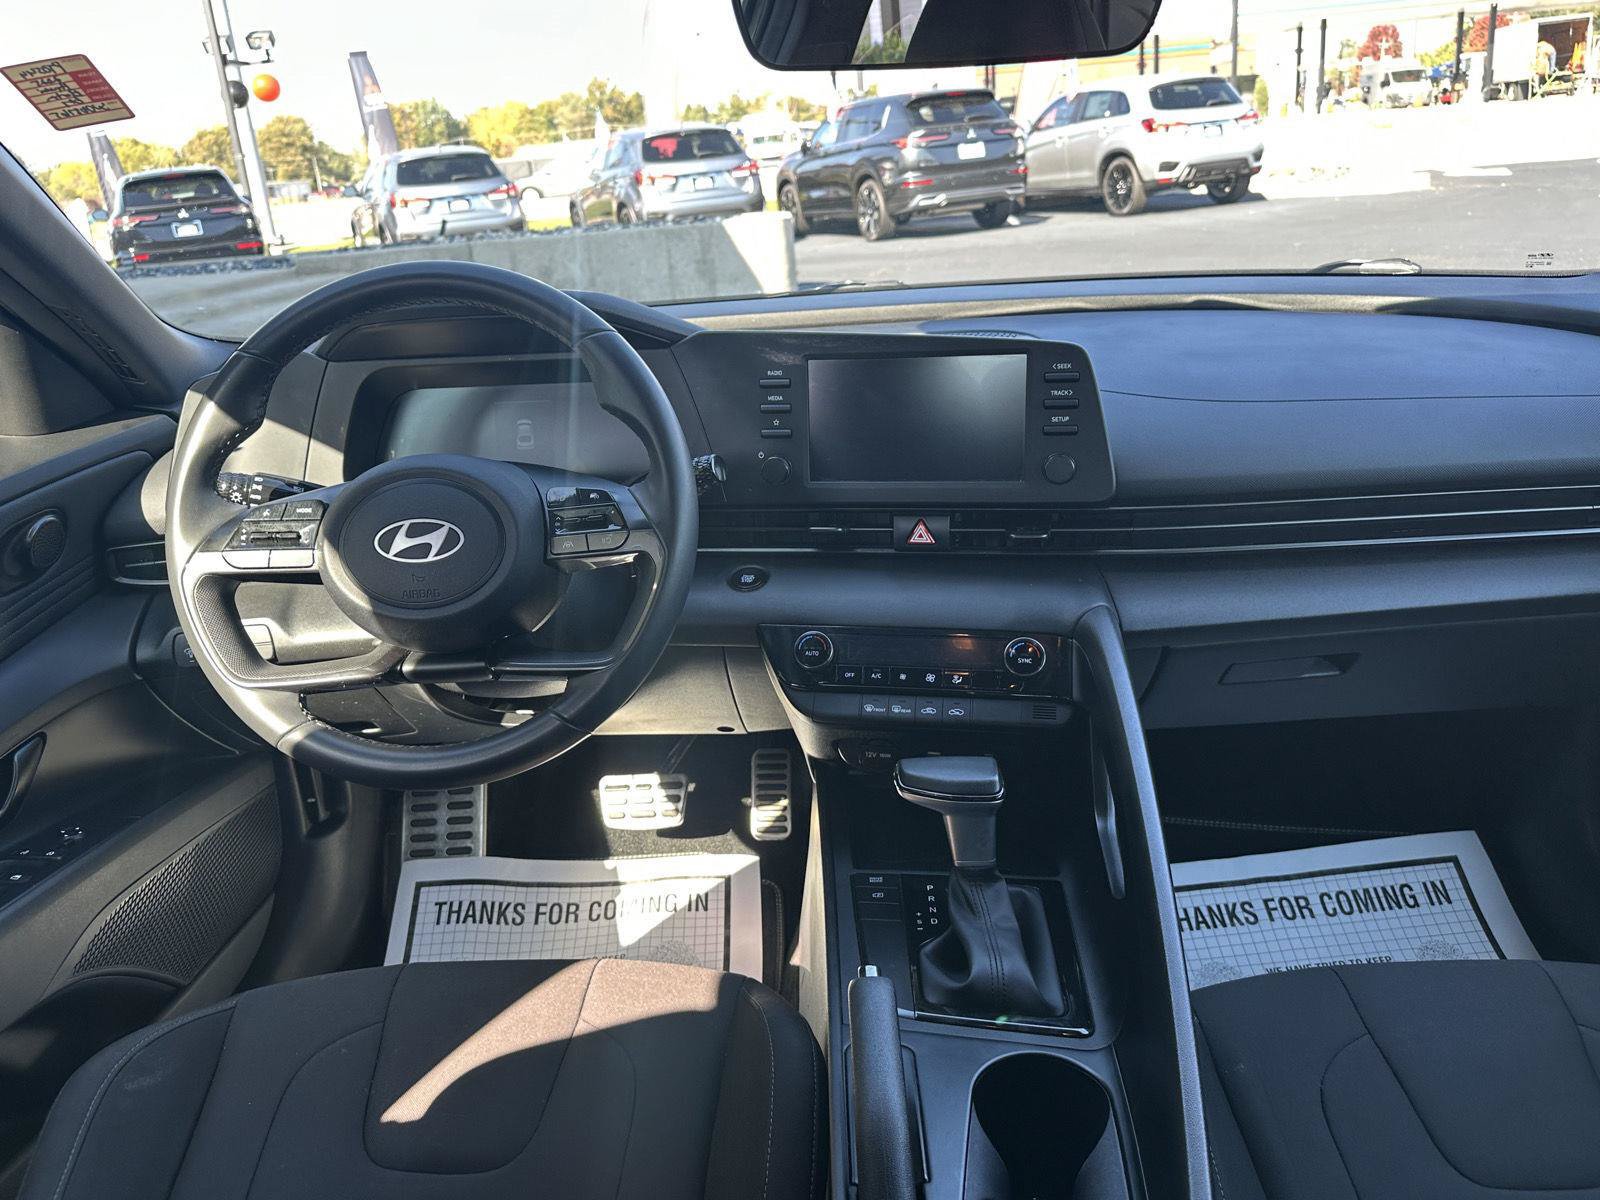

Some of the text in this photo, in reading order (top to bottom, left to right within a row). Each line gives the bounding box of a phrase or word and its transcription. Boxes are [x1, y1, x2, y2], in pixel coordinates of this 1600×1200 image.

[401, 589, 440, 600] AIRBAG
[435, 900, 526, 926] THANKS
[534, 902, 580, 925] FOR
[687, 892, 709, 912] IN
[1178, 880, 1453, 932] HANKS FOR COMING IN
